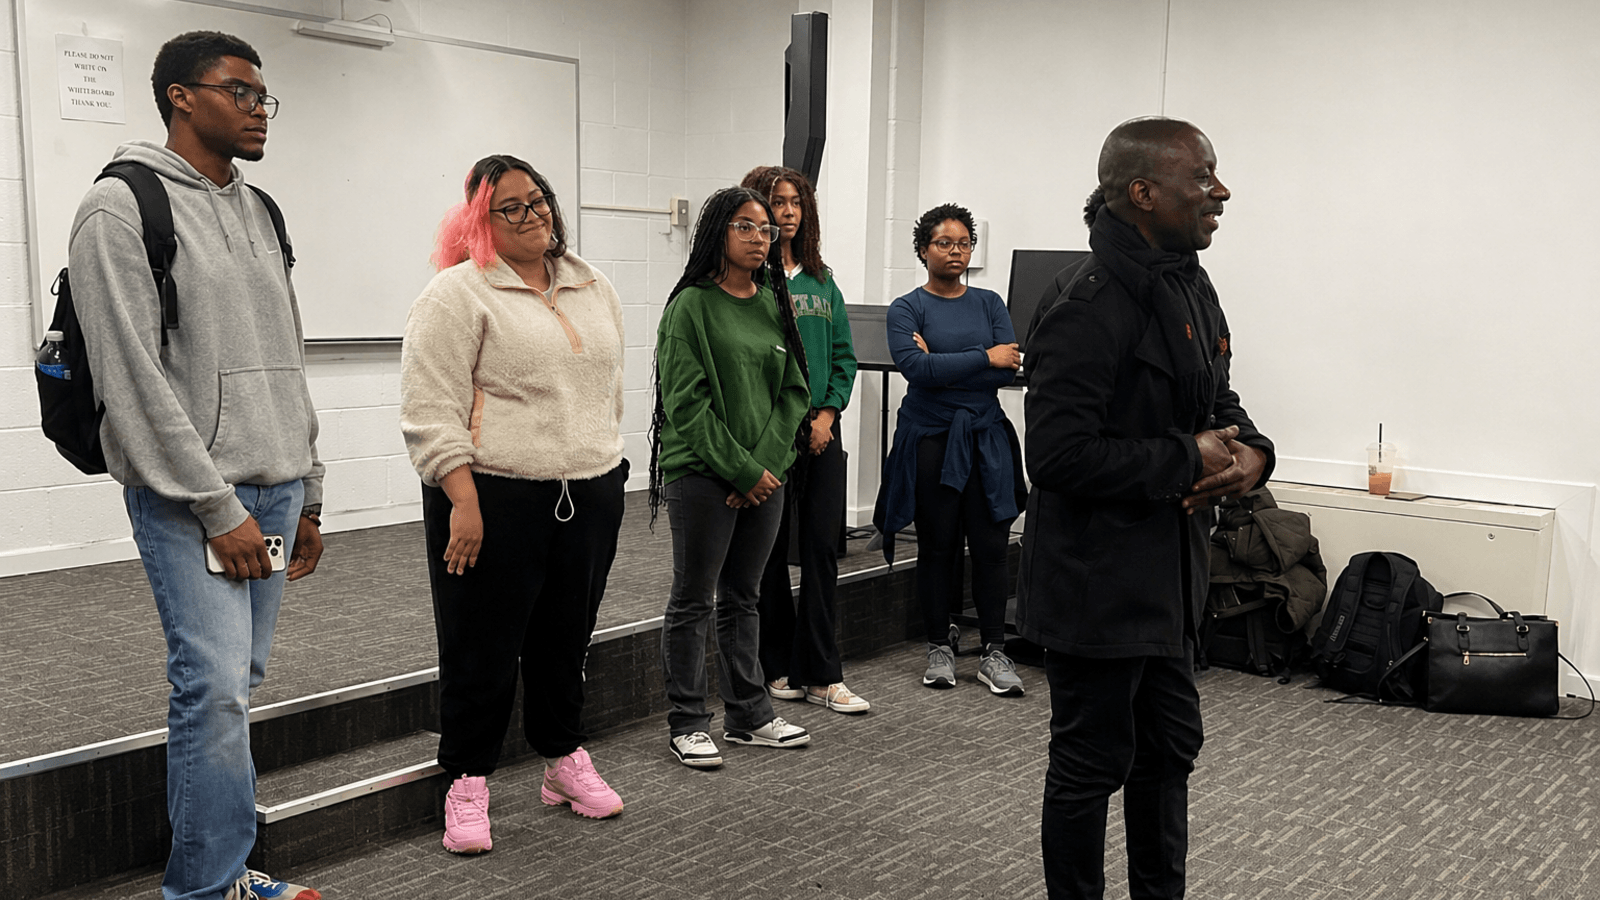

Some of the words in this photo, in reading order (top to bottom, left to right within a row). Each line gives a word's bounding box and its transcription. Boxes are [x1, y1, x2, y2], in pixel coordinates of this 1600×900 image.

[64, 50, 87, 59] PLEASE
[74, 63, 95, 71] WRITE
[67, 86, 115, 96] WHITEBOARD
[71, 98, 95, 107] THANK
